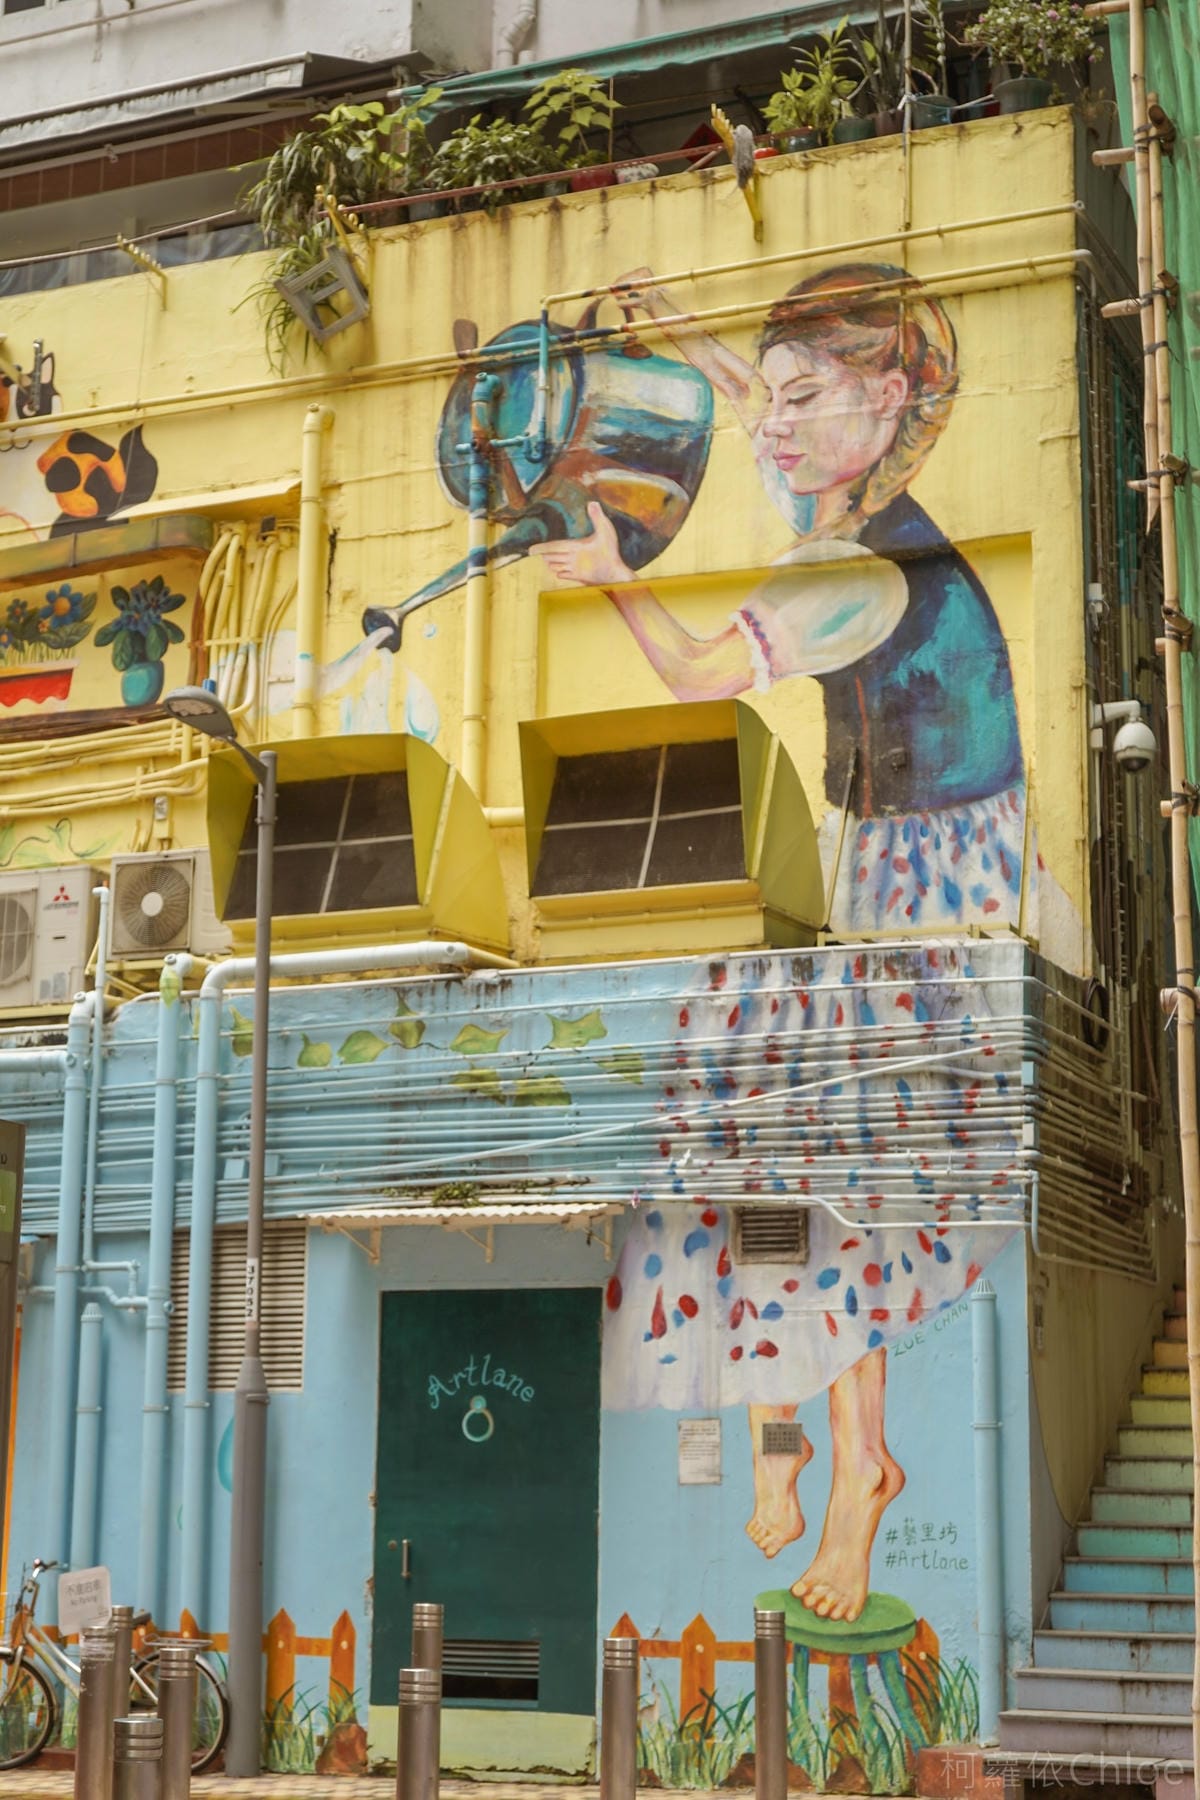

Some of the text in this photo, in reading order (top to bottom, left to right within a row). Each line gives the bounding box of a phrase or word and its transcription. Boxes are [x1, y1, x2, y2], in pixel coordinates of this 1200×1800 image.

[246, 1265, 255, 1317] 37052
[934, 1302, 968, 1332] CHAN
[428, 1353, 535, 1409] Artlane
[884, 1549, 969, 1569] #Artlane
